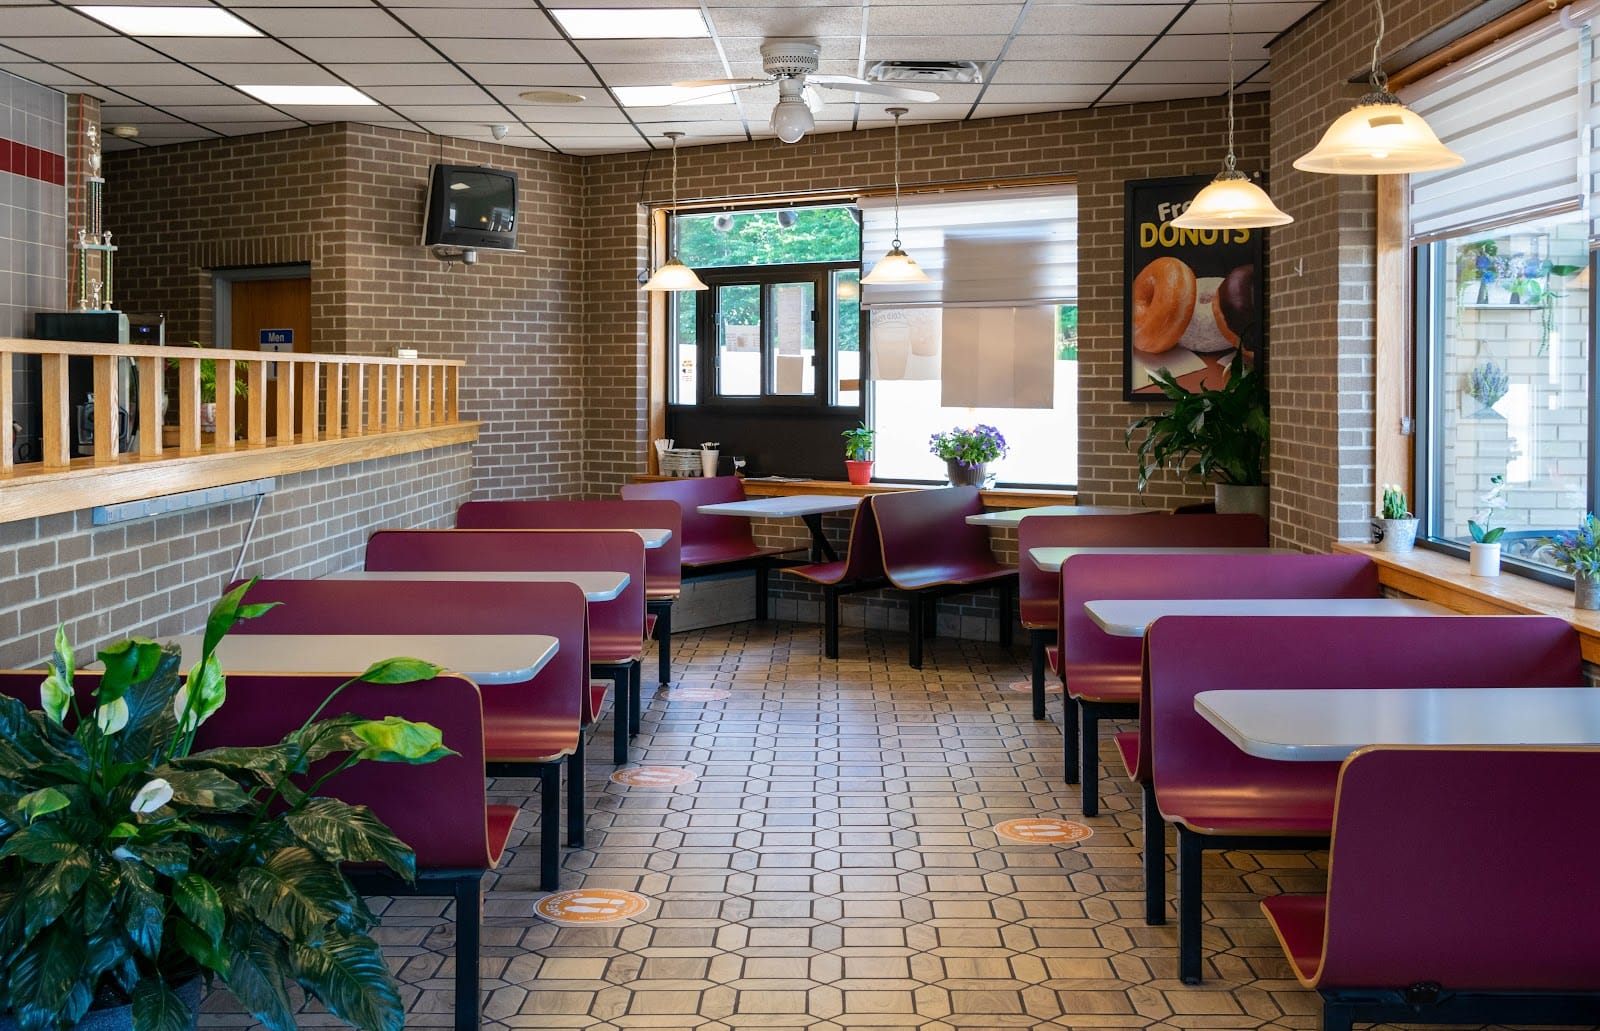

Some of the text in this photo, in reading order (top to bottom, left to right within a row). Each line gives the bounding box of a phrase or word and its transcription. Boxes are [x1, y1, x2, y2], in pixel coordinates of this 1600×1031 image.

[1157, 200, 1193, 222] Fre
[1140, 222, 1250, 248] DONUTS
[268, 332, 284, 342] Men
